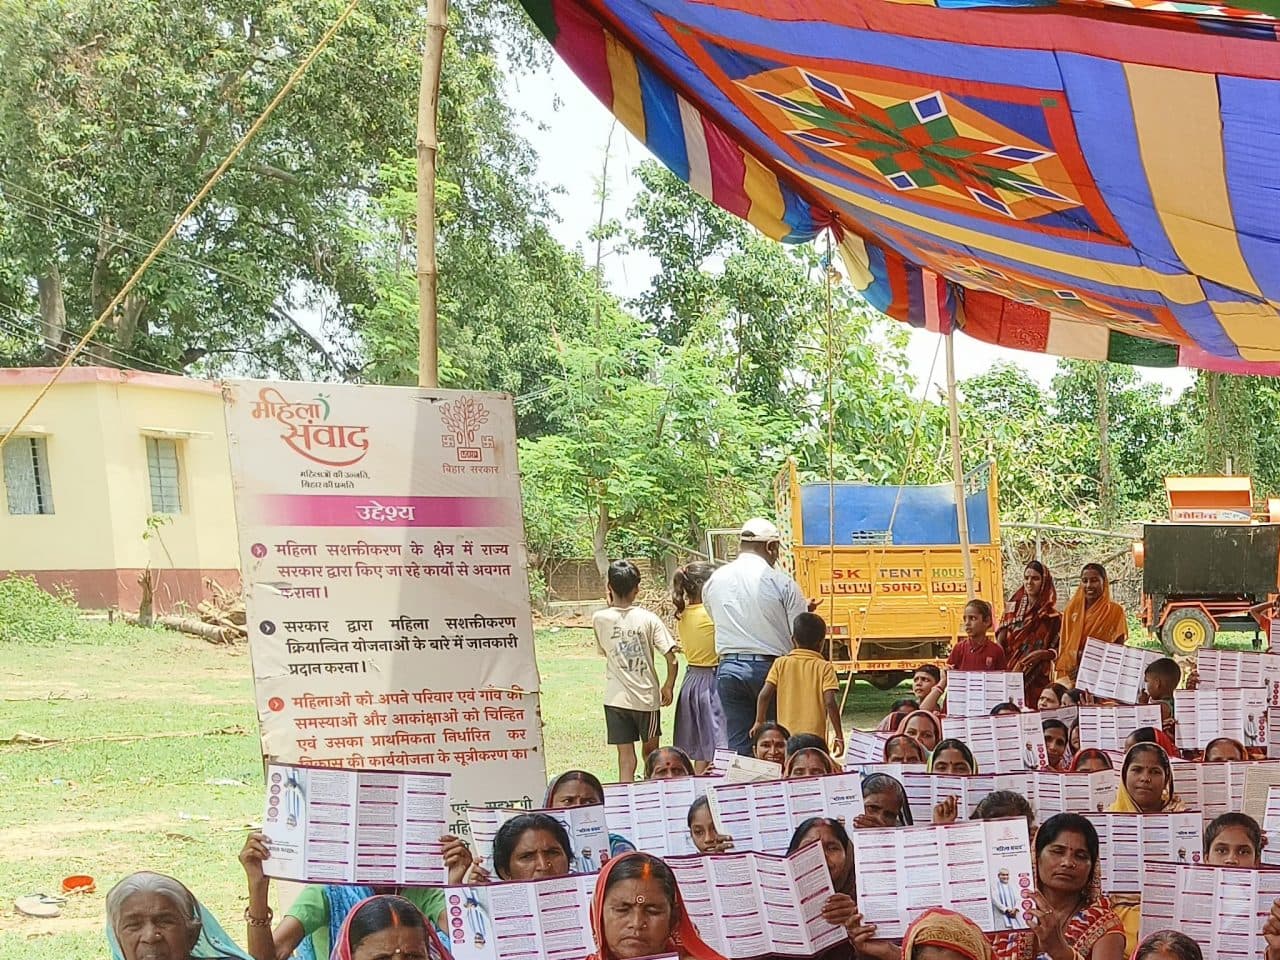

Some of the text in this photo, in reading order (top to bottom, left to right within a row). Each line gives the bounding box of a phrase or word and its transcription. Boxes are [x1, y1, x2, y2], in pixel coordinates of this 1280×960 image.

[250, 387, 330, 422] महिला
[281, 419, 370, 467] संवाद
[443, 463, 500, 474] बिहार सरकार
[355, 500, 416, 522] उद्देश्य
[275, 540, 510, 558] महिला सशक्तीकरण के क्षेत्र में राज्य
[277, 561, 511, 579] सरकार द्वारा किए जा रहे कार्यों से अवगत
[832, 569, 860, 579] SK
[879, 569, 923, 578] TENT
[820, 583, 872, 595] BLOW
[283, 614, 517, 634] सरकार द्वारा महिला सशक्तीकरण
[286, 633, 519, 655] क्रियान्वित योजनाओं के बारे में जानकारी
[288, 662, 321, 676] प्रदान
[292, 692, 351, 710] महिलाओं
[355, 690, 373, 707] को
[379, 690, 410, 705] अपने
[413, 689, 454, 705] परिवार
[458, 688, 476, 704] एवं
[507, 685, 524, 701] की
[294, 706, 525, 729] समस्याओं और आकांक्षाओं को चिन्हित
[296, 727, 528, 752] एवं उसका प्राथमिकता निर्धारित कर
[347, 754, 365, 769] की
[367, 751, 434, 768] कार्ययोजना
[437, 749, 451, 764] के
[453, 747, 508, 766] सूत्रीकरण
[510, 747, 529, 760] का
